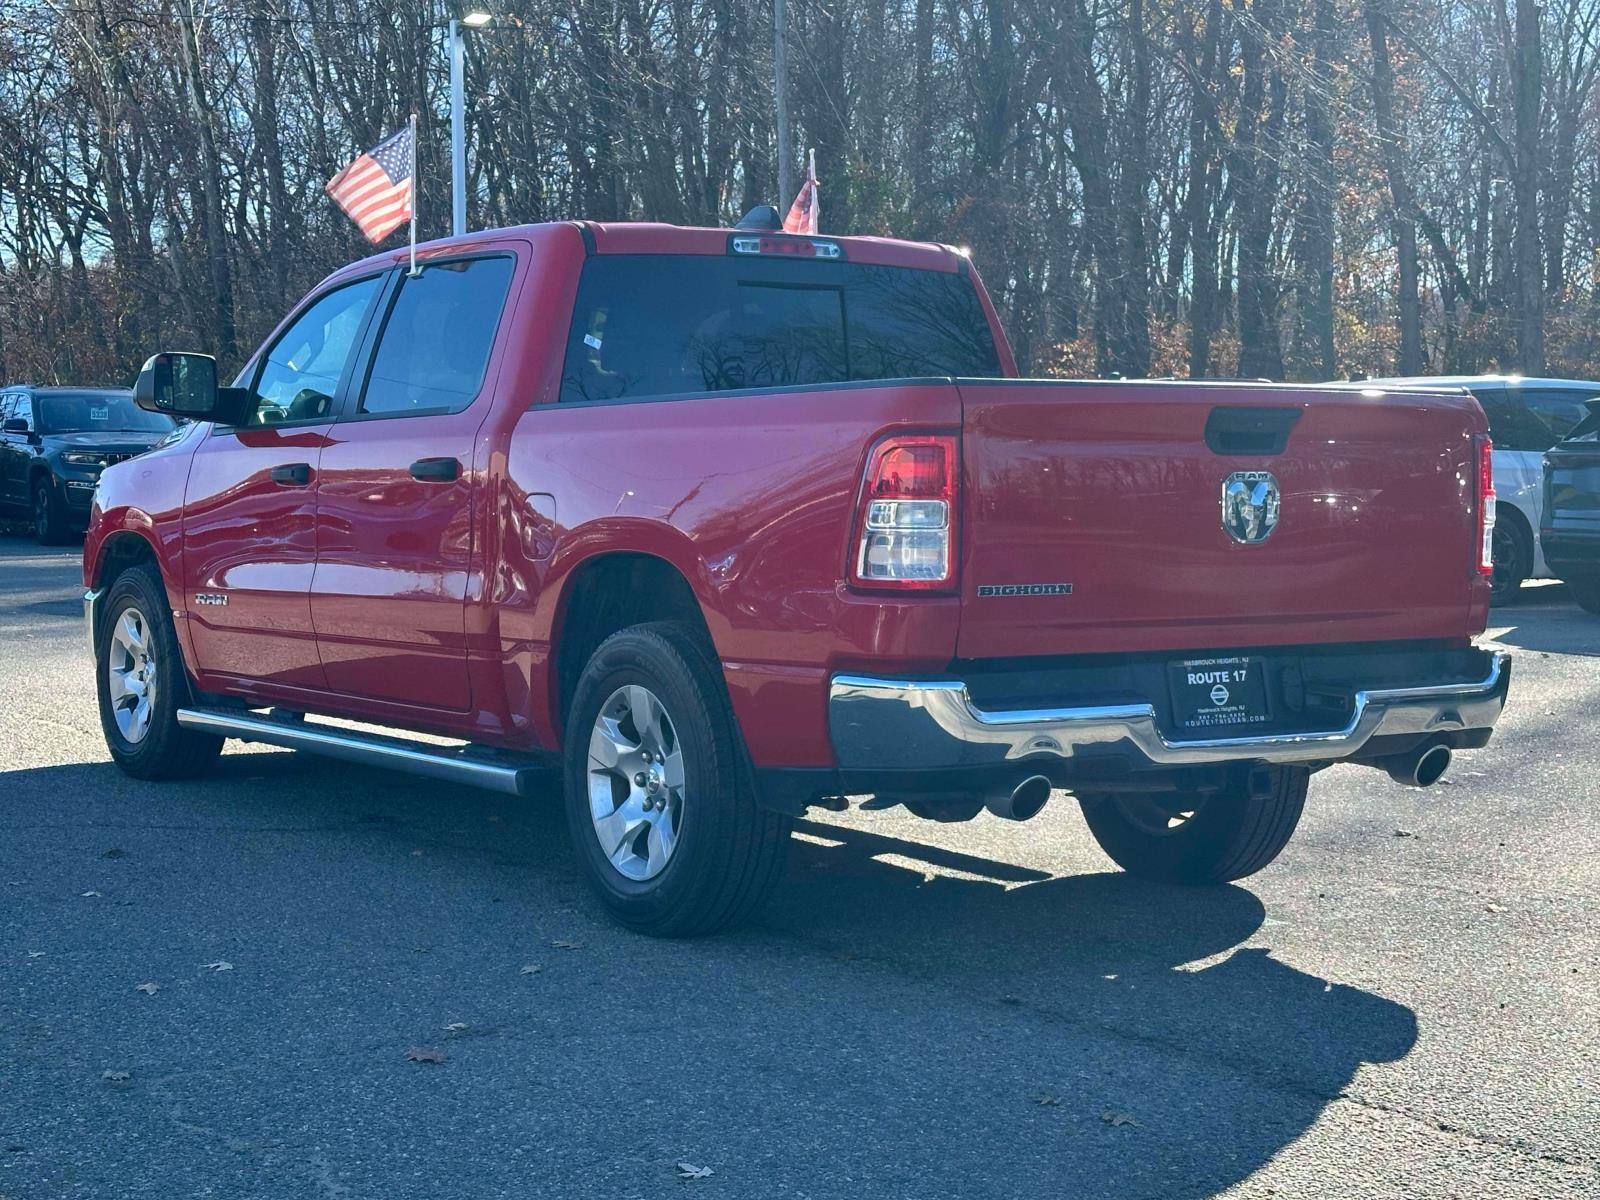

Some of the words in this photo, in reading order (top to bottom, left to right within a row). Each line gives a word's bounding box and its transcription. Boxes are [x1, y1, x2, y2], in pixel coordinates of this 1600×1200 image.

[1234, 472, 1270, 480] RAM
[978, 583, 1073, 597] BIGHORN
[195, 593, 229, 606] RAM
[1187, 671, 1230, 685] ROUTE
[1233, 670, 1247, 682] 17
